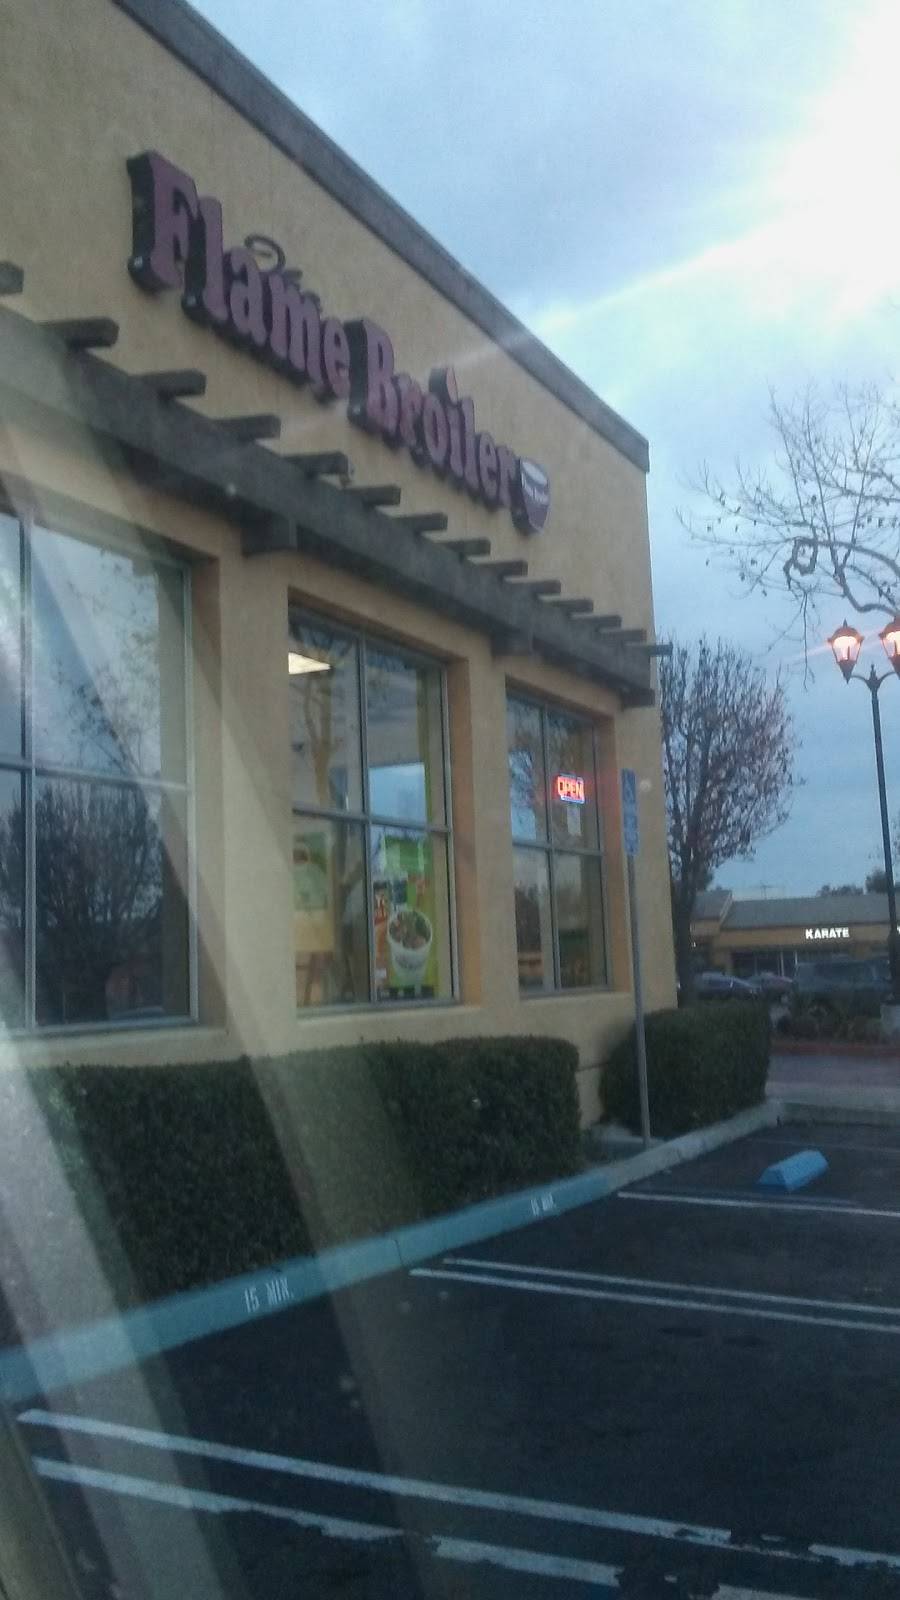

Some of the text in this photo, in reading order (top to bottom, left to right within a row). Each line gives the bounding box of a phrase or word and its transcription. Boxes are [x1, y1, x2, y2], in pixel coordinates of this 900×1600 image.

[128, 150, 518, 510] Flame Broiler
[557, 776, 584, 801] OPEN
[805, 927, 850, 939] KARATE
